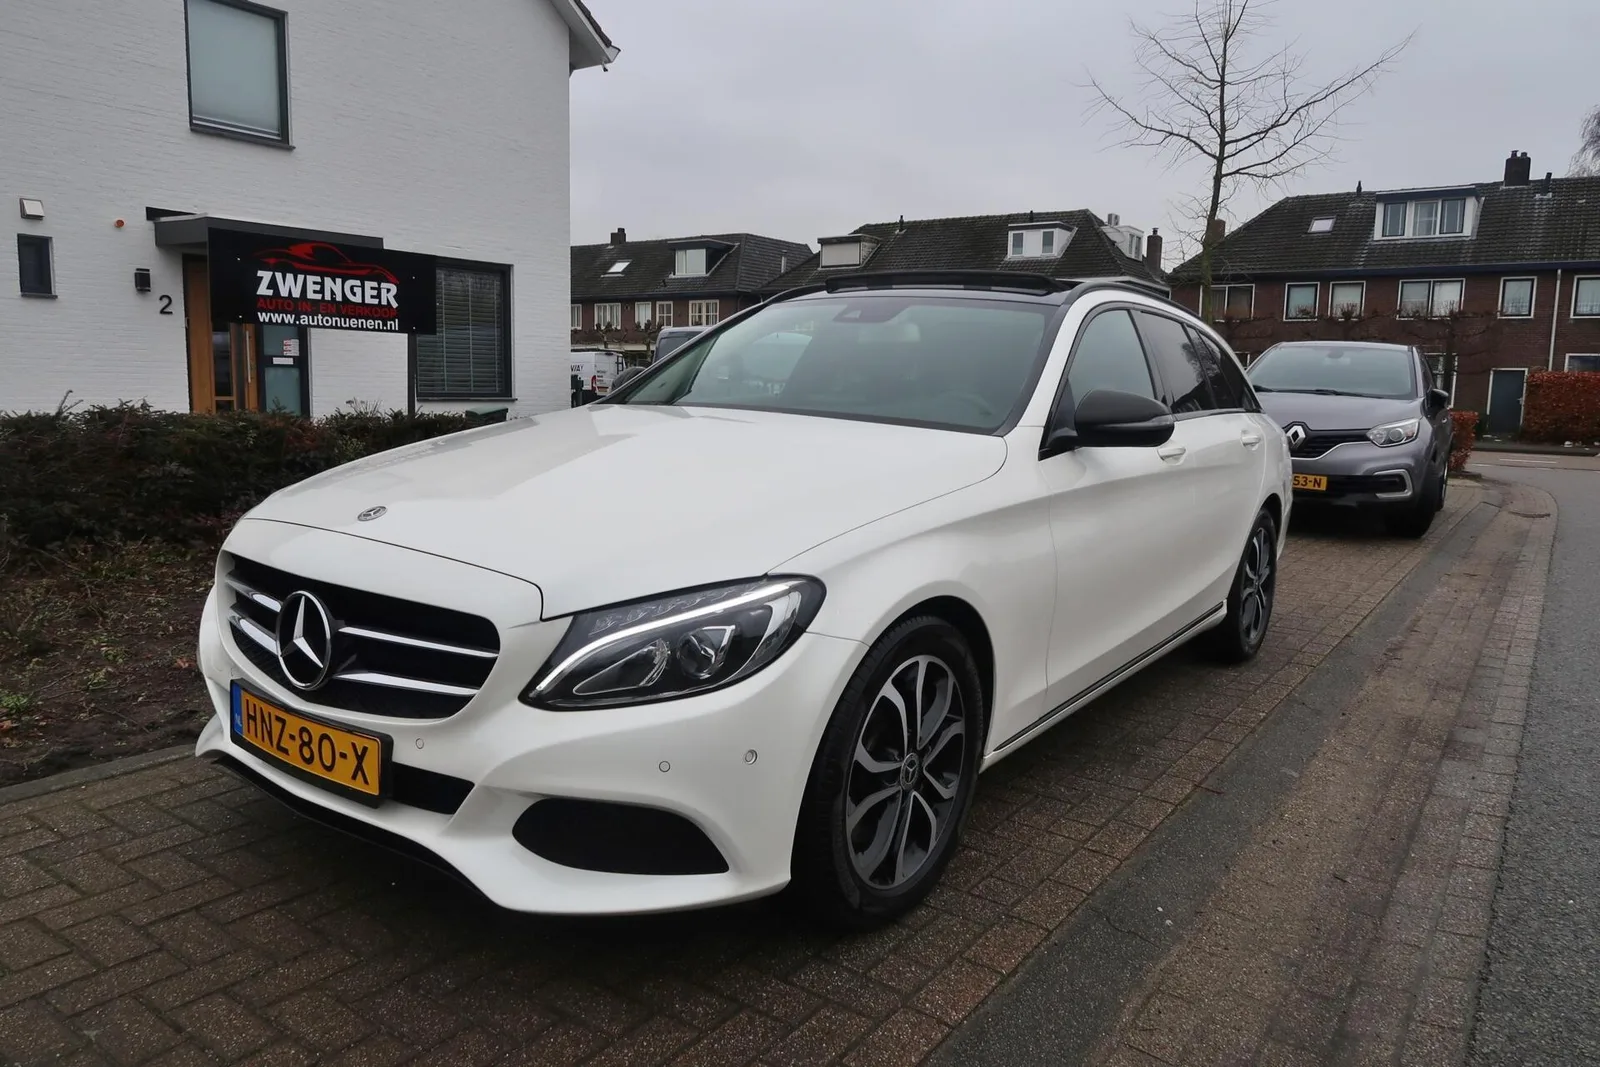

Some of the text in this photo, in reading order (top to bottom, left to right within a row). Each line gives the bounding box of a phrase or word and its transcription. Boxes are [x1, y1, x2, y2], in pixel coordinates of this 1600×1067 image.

[256, 270, 399, 309] ZWENGER
[159, 294, 173, 315] 2
[257, 298, 397, 318] AUTO IN- EN VERKOOP
[257, 312, 399, 331] www.autonuenen.nl
[1293, 475, 1322, 489] 53-N
[235, 713, 243, 727] NL
[245, 698, 370, 786] HNZ-80-X
